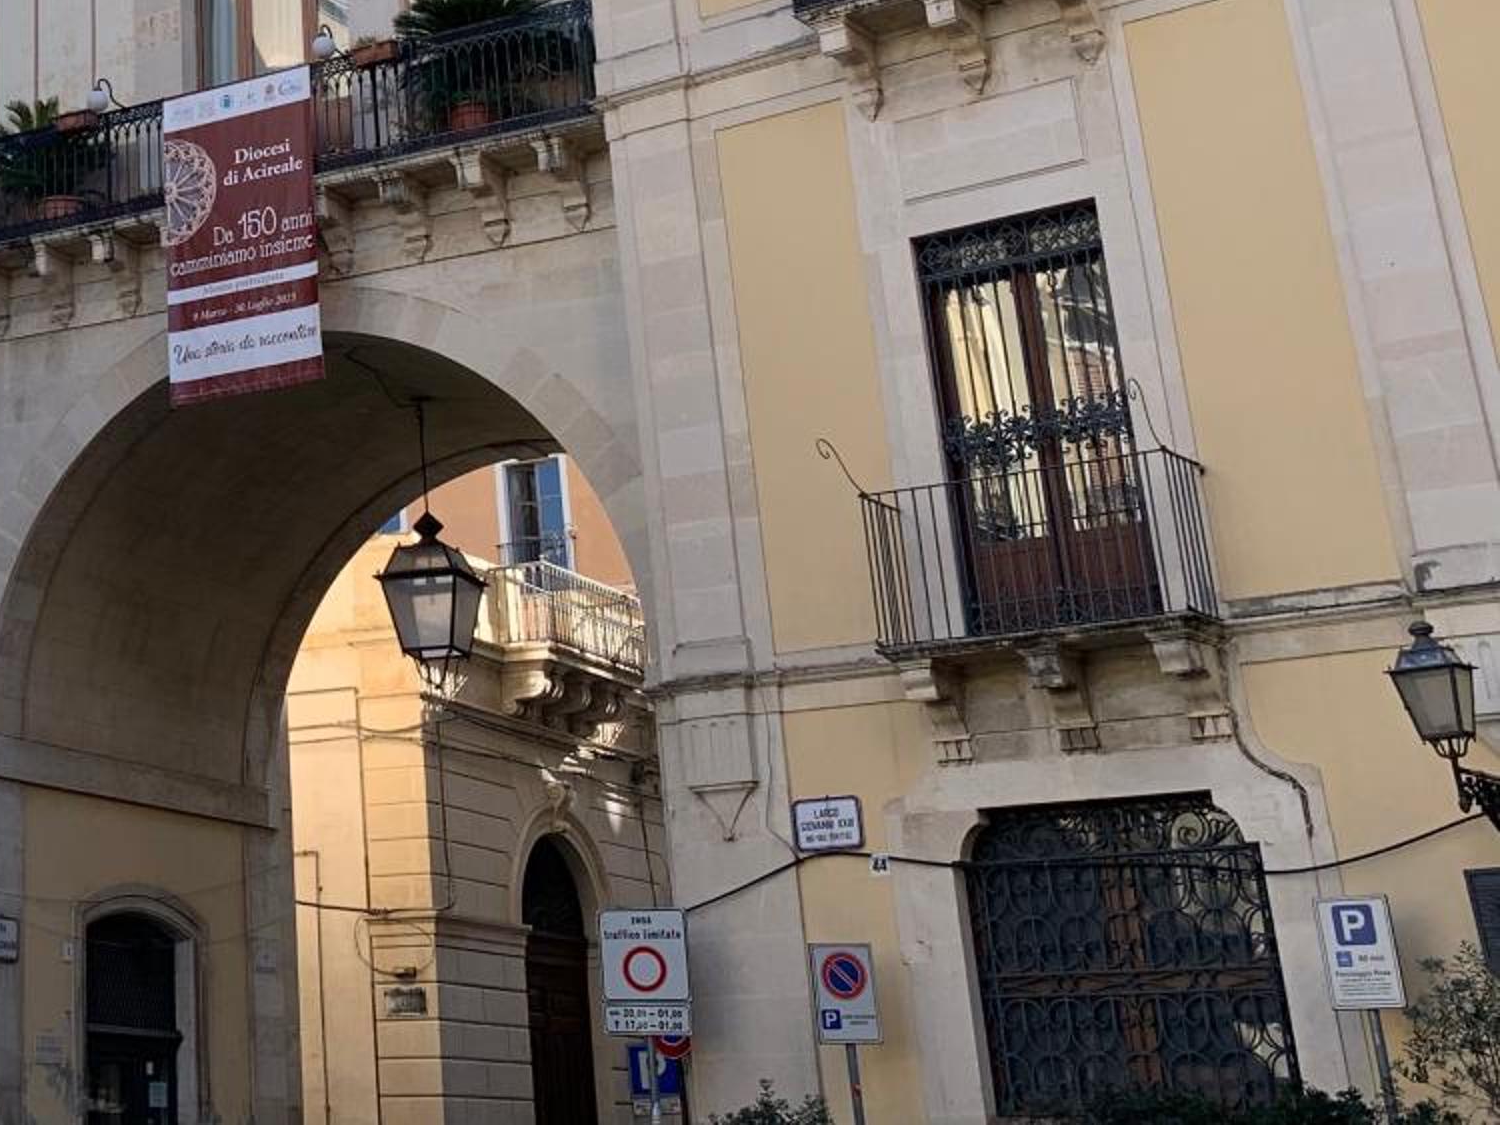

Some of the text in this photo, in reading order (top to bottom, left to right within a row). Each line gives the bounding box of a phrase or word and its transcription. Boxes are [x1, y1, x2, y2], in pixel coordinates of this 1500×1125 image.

[234, 138, 291, 164] Diocesi
[223, 156, 303, 186] di Acireale
[213, 206, 313, 246] Da 150 anni
[170, 233, 314, 276] camminiamo insieme
[173, 344, 201, 365] Una
[204, 339, 235, 357] storia
[239, 334, 255, 350] da
[813, 807, 839, 819] LARGO
[604, 928, 641, 940] traffico
[1338, 910, 1365, 941] P
[825, 1012, 837, 1028] P
